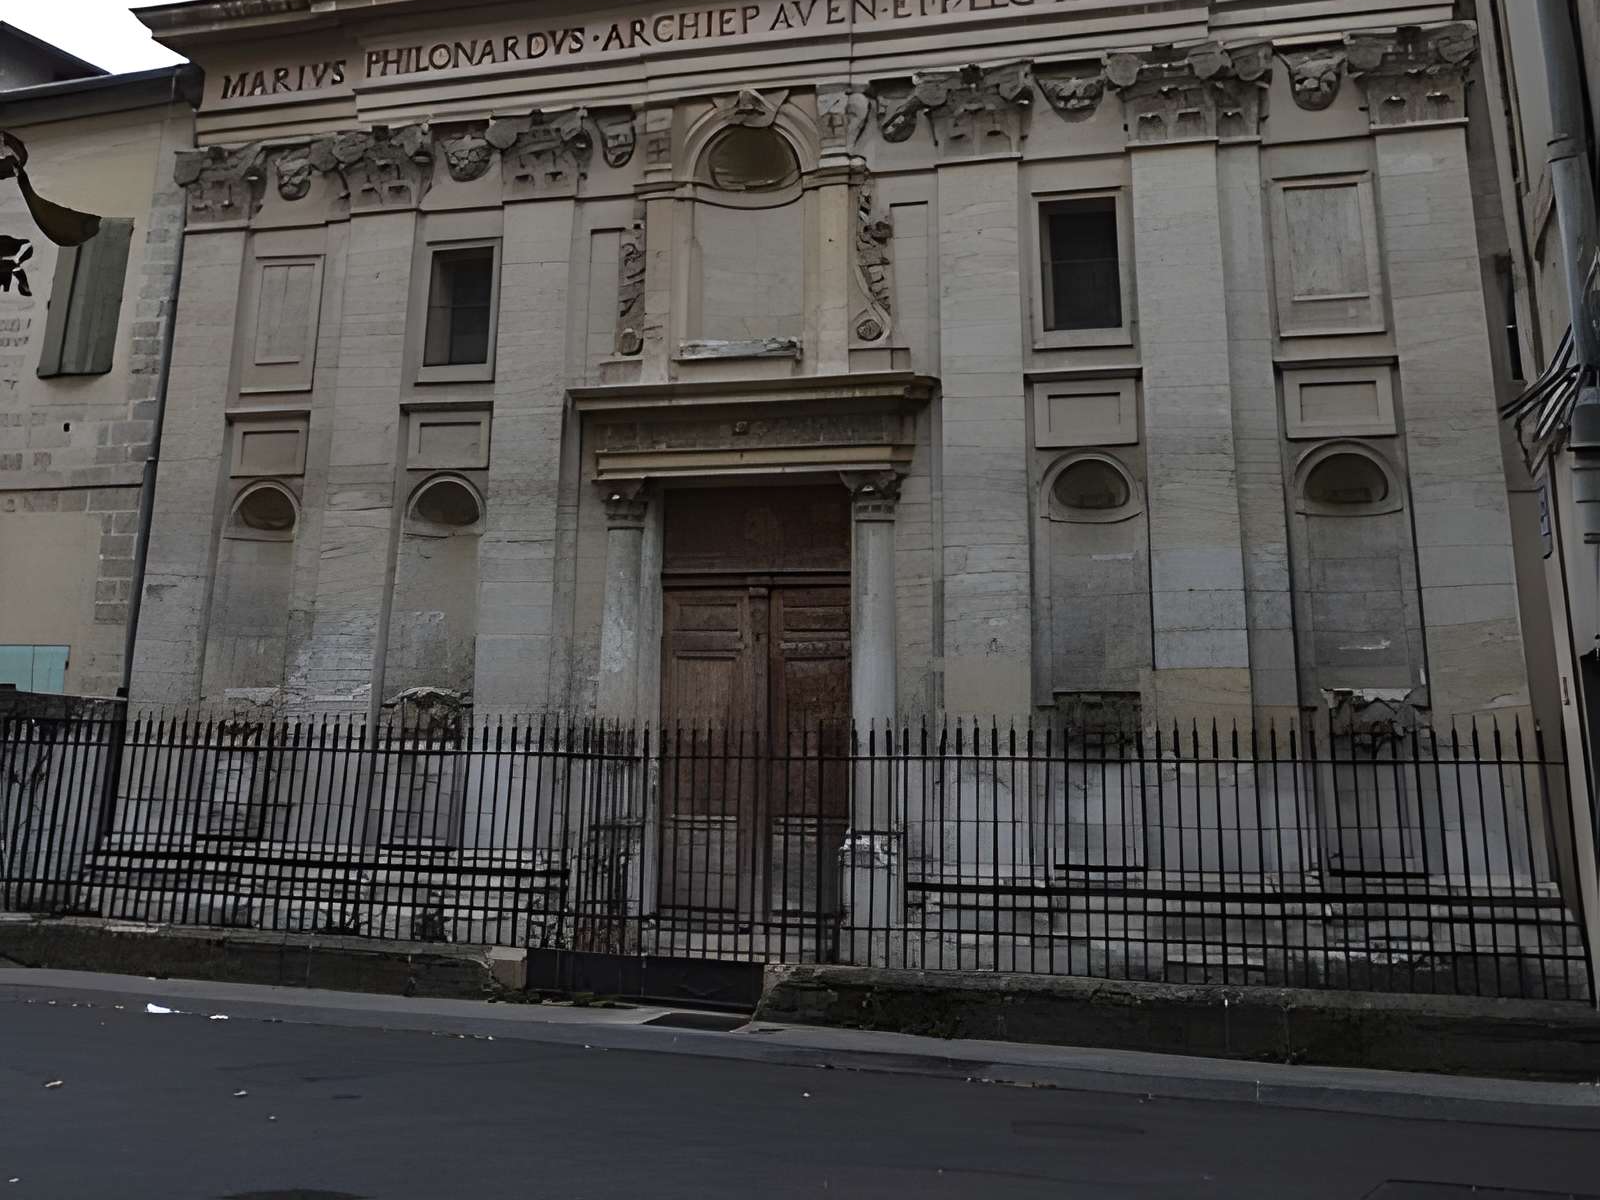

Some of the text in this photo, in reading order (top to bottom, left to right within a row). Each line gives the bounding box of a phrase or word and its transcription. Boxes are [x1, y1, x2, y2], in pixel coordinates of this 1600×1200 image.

[220, 59, 346, 99] MARIVS
[366, 27, 585, 78] PHILONARDVS
[601, 4, 760, 52] ARCHIEP
